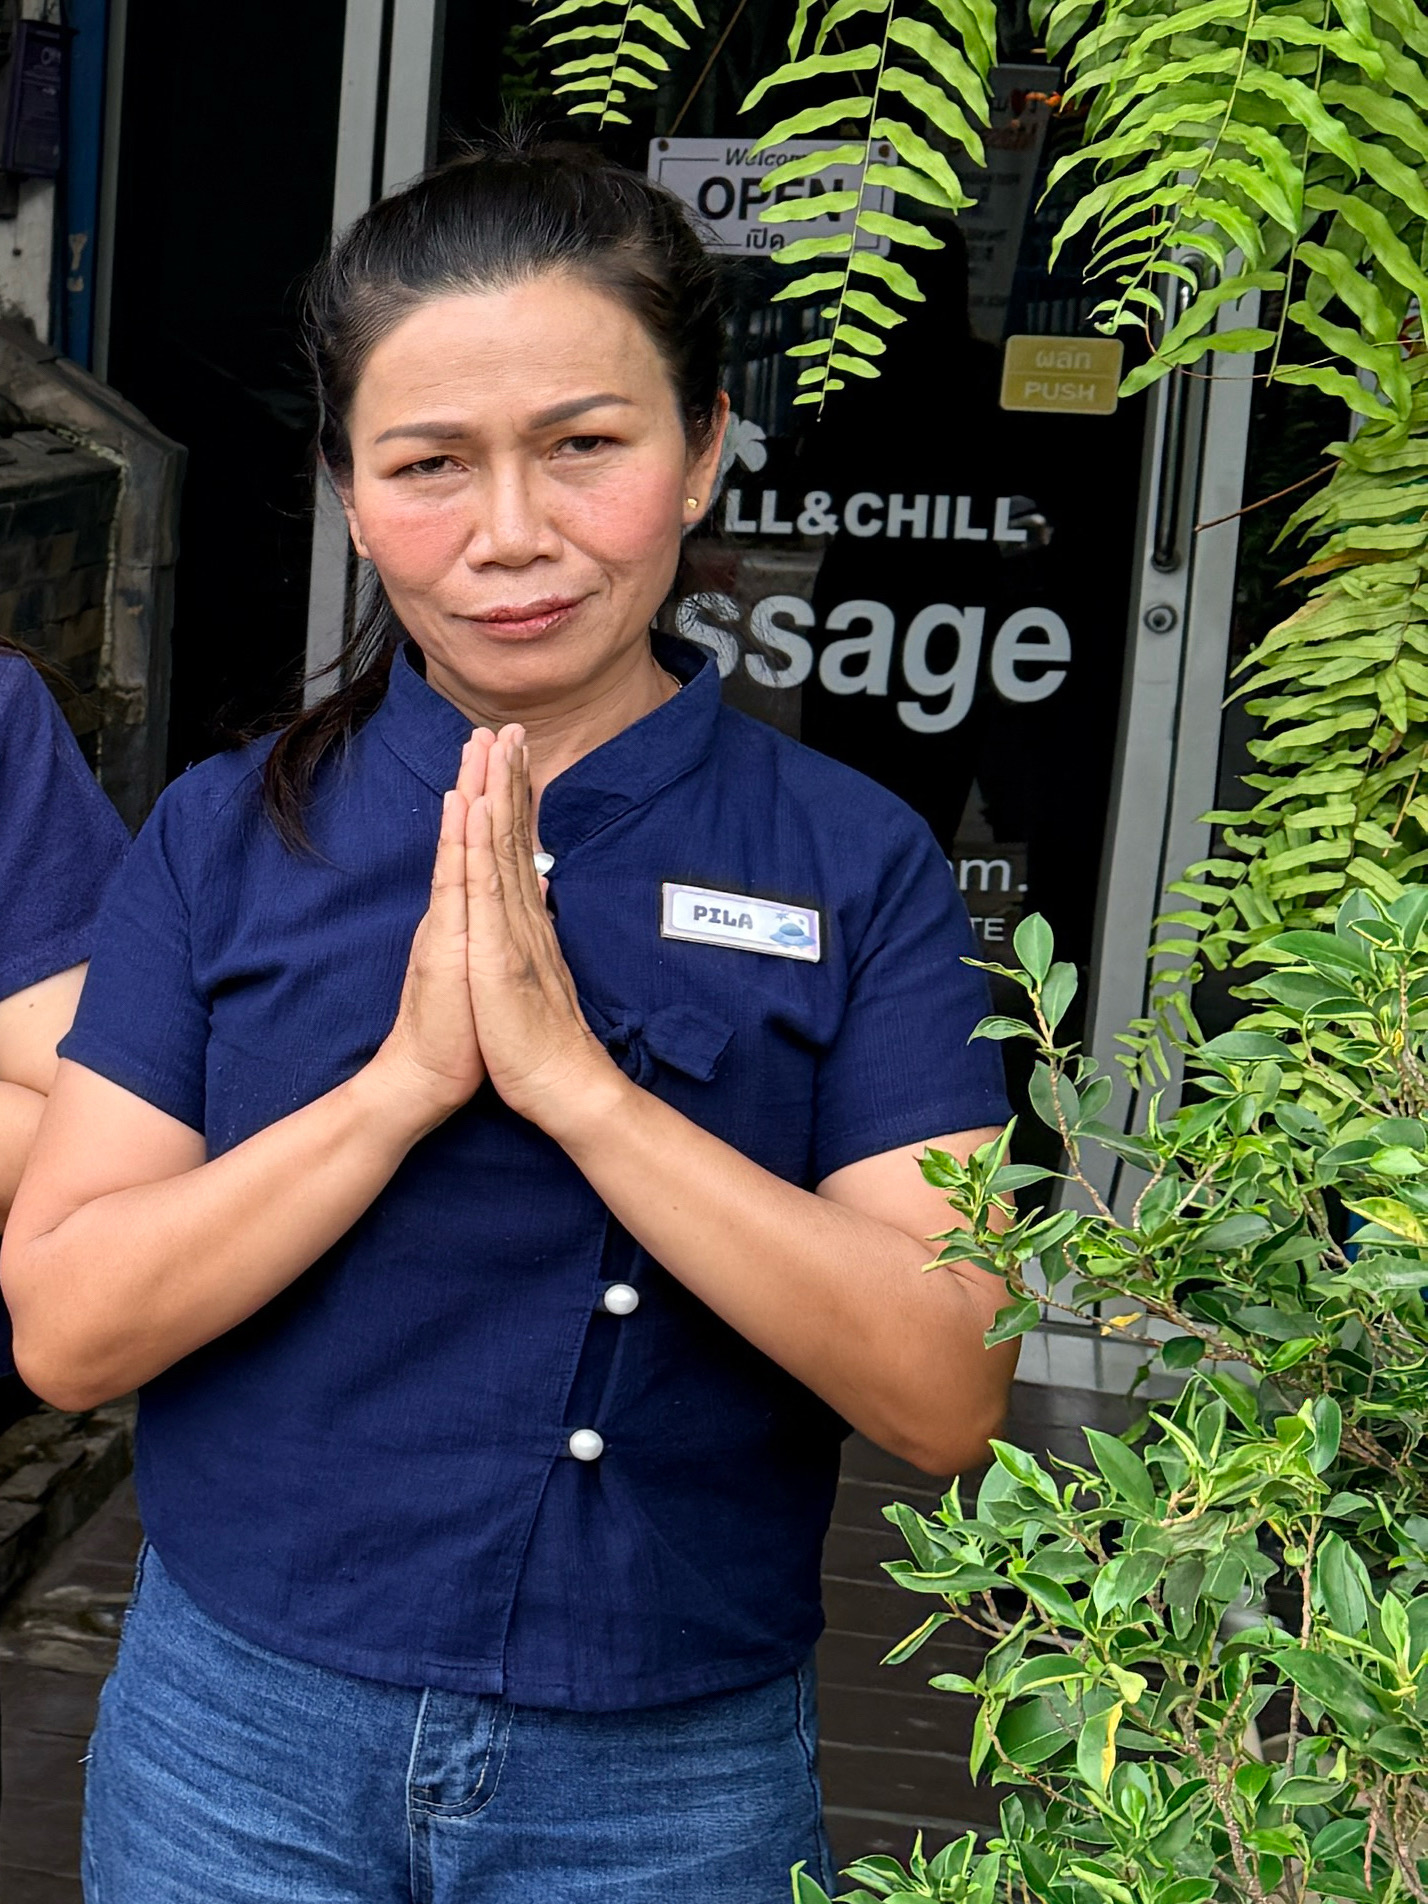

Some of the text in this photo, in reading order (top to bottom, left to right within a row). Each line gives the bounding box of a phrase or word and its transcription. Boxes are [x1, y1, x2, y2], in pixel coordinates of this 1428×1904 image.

[1034, 346, 1092, 370] ผลัก
[1023, 381, 1097, 402] PUSH
[723, 488, 1029, 543] LL&CHILL
[675, 590, 1073, 735] ssage
[692, 904, 754, 929] PILA
